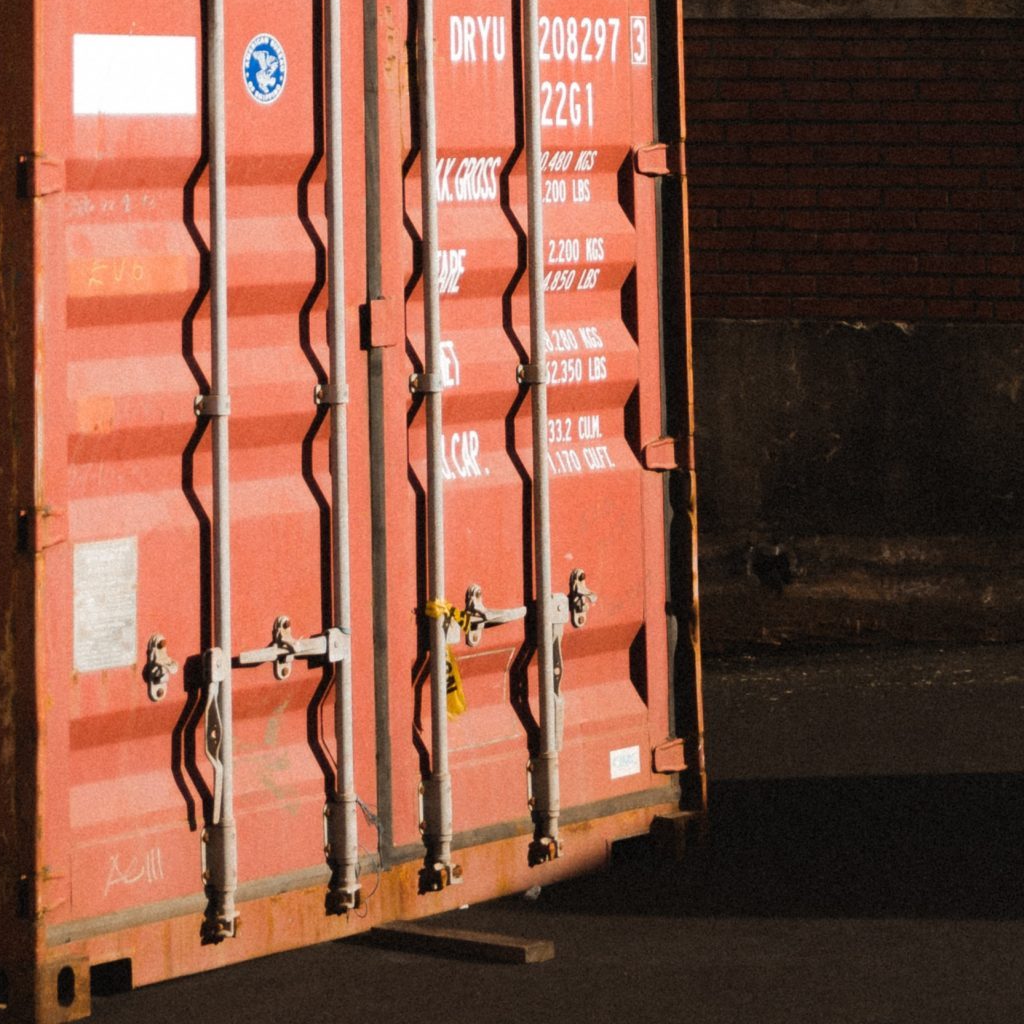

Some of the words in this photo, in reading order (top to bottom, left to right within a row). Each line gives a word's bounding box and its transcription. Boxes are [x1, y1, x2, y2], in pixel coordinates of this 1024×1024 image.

[449, 15, 506, 62] DRYU
[538, 15, 620, 62] 208297
[632, 18, 646, 62] 3
[540, 80, 594, 127] 22G1
[539, 150, 574, 173] 0.480
[574, 149, 598, 172] KGS
[454, 155, 502, 202] GROSS
[572, 178, 591, 203] LBS
[548, 238, 580, 264] 2.200
[585, 236, 605, 262] KGS
[576, 268, 601, 291] LBS
[578, 326, 604, 350] KGS
[588, 355, 608, 382] LBS
